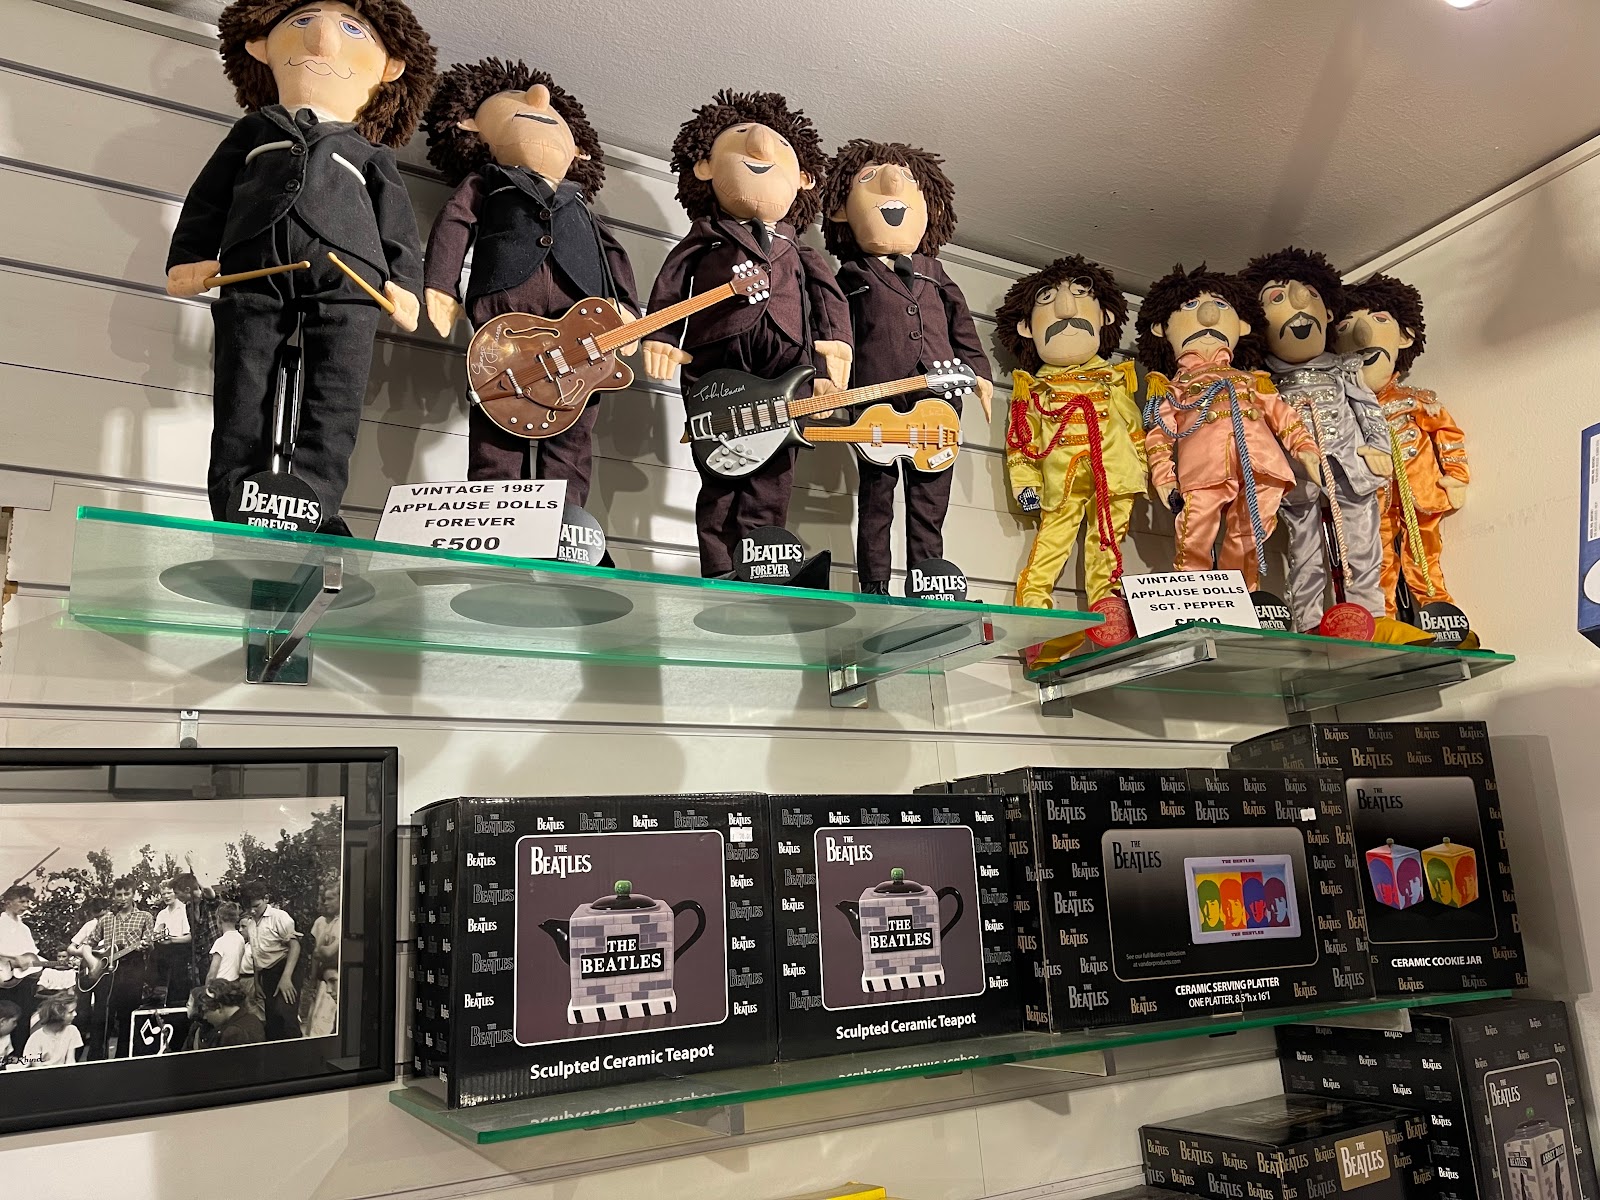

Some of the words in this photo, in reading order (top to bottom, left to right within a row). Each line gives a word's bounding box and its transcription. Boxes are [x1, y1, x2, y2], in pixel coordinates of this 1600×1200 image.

[411, 485, 494, 496] VINTAGE
[502, 484, 545, 493] 1987
[238, 481, 320, 520] BEATLES
[389, 501, 490, 514] APPLAUSE
[497, 500, 558, 509] DOLLS
[424, 517, 515, 528] FOREVER
[560, 524, 602, 547] ATLES
[430, 537, 500, 550] £500
[742, 538, 801, 564] BEATLES
[559, 546, 590, 561] REVER
[750, 564, 790, 576] FOREVER
[911, 569, 966, 593] BEATLES
[1137, 575, 1195, 585] VINTAGE
[1131, 588, 1199, 599] APPLAUSE
[1203, 586, 1244, 594] DOLLS
[1150, 603, 1180, 611] SGT.
[1185, 600, 1234, 609] PEPPER
[1255, 605, 1290, 621] EATLES
[1260, 620, 1285, 630] OREVER
[1419, 611, 1468, 630] BEATLES
[1434, 631, 1460, 640] OREVER
[1324, 728, 1349, 742] BEATLES
[1368, 728, 1393, 742] BEATLES
[1415, 728, 1440, 742] BEATLES
[1351, 748, 1393, 769] BEATLES
[1407, 752, 1432, 765] BEATLES
[1442, 747, 1483, 767] BEATLES
[1070, 776, 1097, 793] BEATLES
[1119, 777, 1145, 793] BEATLES
[1161, 777, 1185, 793] BEATLES
[1205, 778, 1229, 793] BEATLES
[1243, 778, 1266, 793] BEATLES
[1284, 778, 1307, 794] BEATLES
[1320, 779, 1340, 794] BEATLES
[1357, 789, 1403, 812] BEATLES
[1047, 799, 1086, 824] BEATLES
[1110, 800, 1147, 824] BEATLES
[1160, 801, 1185, 817] BEATLES
[1195, 800, 1229, 823] BEATLES
[1243, 801, 1266, 817] BEATLES
[1320, 801, 1342, 816] BEATLES
[537, 818, 564, 832] BEATLES
[633, 815, 658, 829] BEATLES
[728, 813, 751, 826] BEATLES
[829, 812, 850, 825] BEATLES
[901, 811, 921, 824] BEATLES
[474, 815, 515, 836] BEATLES
[1052, 834, 1080, 852] BEATLES
[1307, 830, 1329, 845] BEATLES
[778, 842, 800, 855] BEATLES
[826, 837, 873, 865] BEATLES
[467, 853, 496, 868] BEATLES
[531, 846, 592, 879] BEATLES
[1112, 842, 1162, 873] BEATLES
[1313, 855, 1336, 871] BEATLES
[1072, 863, 1099, 880] BEATLES
[730, 875, 753, 889] BEATLES
[1320, 881, 1343, 896] BEATLES
[782, 899, 804, 912] BEATLES
[1054, 892, 1094, 916] BEATLES
[468, 918, 497, 933] BEATLES
[888, 919, 911, 931] THE
[1318, 916, 1341, 931] BEATLES
[607, 938, 636, 952] THE
[732, 937, 756, 951] BEATLES
[870, 932, 931, 949] BEATLES
[1060, 929, 1088, 947] BEATLES
[1324, 940, 1347, 955] BEATLES
[1492, 947, 1517, 960] BEATLES
[581, 953, 662, 974] BEATLES
[1080, 957, 1108, 975] BEATLES
[1391, 958, 1431, 967] CERAMIC
[1432, 957, 1465, 966] COOKIE
[1466, 956, 1482, 965] JAR
[783, 964, 806, 977] BEATLES
[1332, 968, 1364, 989] BEATLES
[1398, 977, 1424, 991] BEATLES
[1176, 983, 1212, 996] CERAMIC
[1213, 980, 1246, 992] SERVING
[1247, 977, 1279, 989] PLATTER
[1294, 983, 1317, 998] BEATLES
[464, 994, 494, 1009] BEATLES
[1068, 986, 1109, 1010] BEATLES
[1189, 998, 1204, 1008] ONE
[1205, 995, 1234, 1007] PLATTER,
[734, 1002, 758, 1016] BEATLES
[1130, 998, 1157, 1015] BEATLES
[1026, 1005, 1048, 1024] BEATLES
[836, 1021, 889, 1040] Sculpted
[891, 1016, 937, 1032] Ceramic
[938, 1013, 976, 1028] Teapot
[530, 1056, 599, 1080] Sculpted
[603, 1050, 663, 1070] Ceramic
[665, 1043, 714, 1065] Teapot
[1489, 1083, 1520, 1107] BEATLES
[1431, 1115, 1451, 1127] BEATLES
[1147, 1139, 1169, 1156] BEATLES
[1179, 1140, 1214, 1165] BEATLES
[1356, 1142, 1365, 1150] THE
[1222, 1152, 1248, 1170] BEATLES
[1314, 1147, 1335, 1162] BEATLES
[1279, 1152, 1309, 1173] BEATLES
[1340, 1147, 1384, 1178] BEATLES
[1171, 1169, 1194, 1186] BEATLES
[1438, 1167, 1459, 1180] BEATLES
[1208, 1173, 1243, 1198] BEATLES
[1247, 1181, 1274, 1200] BEATLES
[1307, 1179, 1336, 1199] BEATLES
